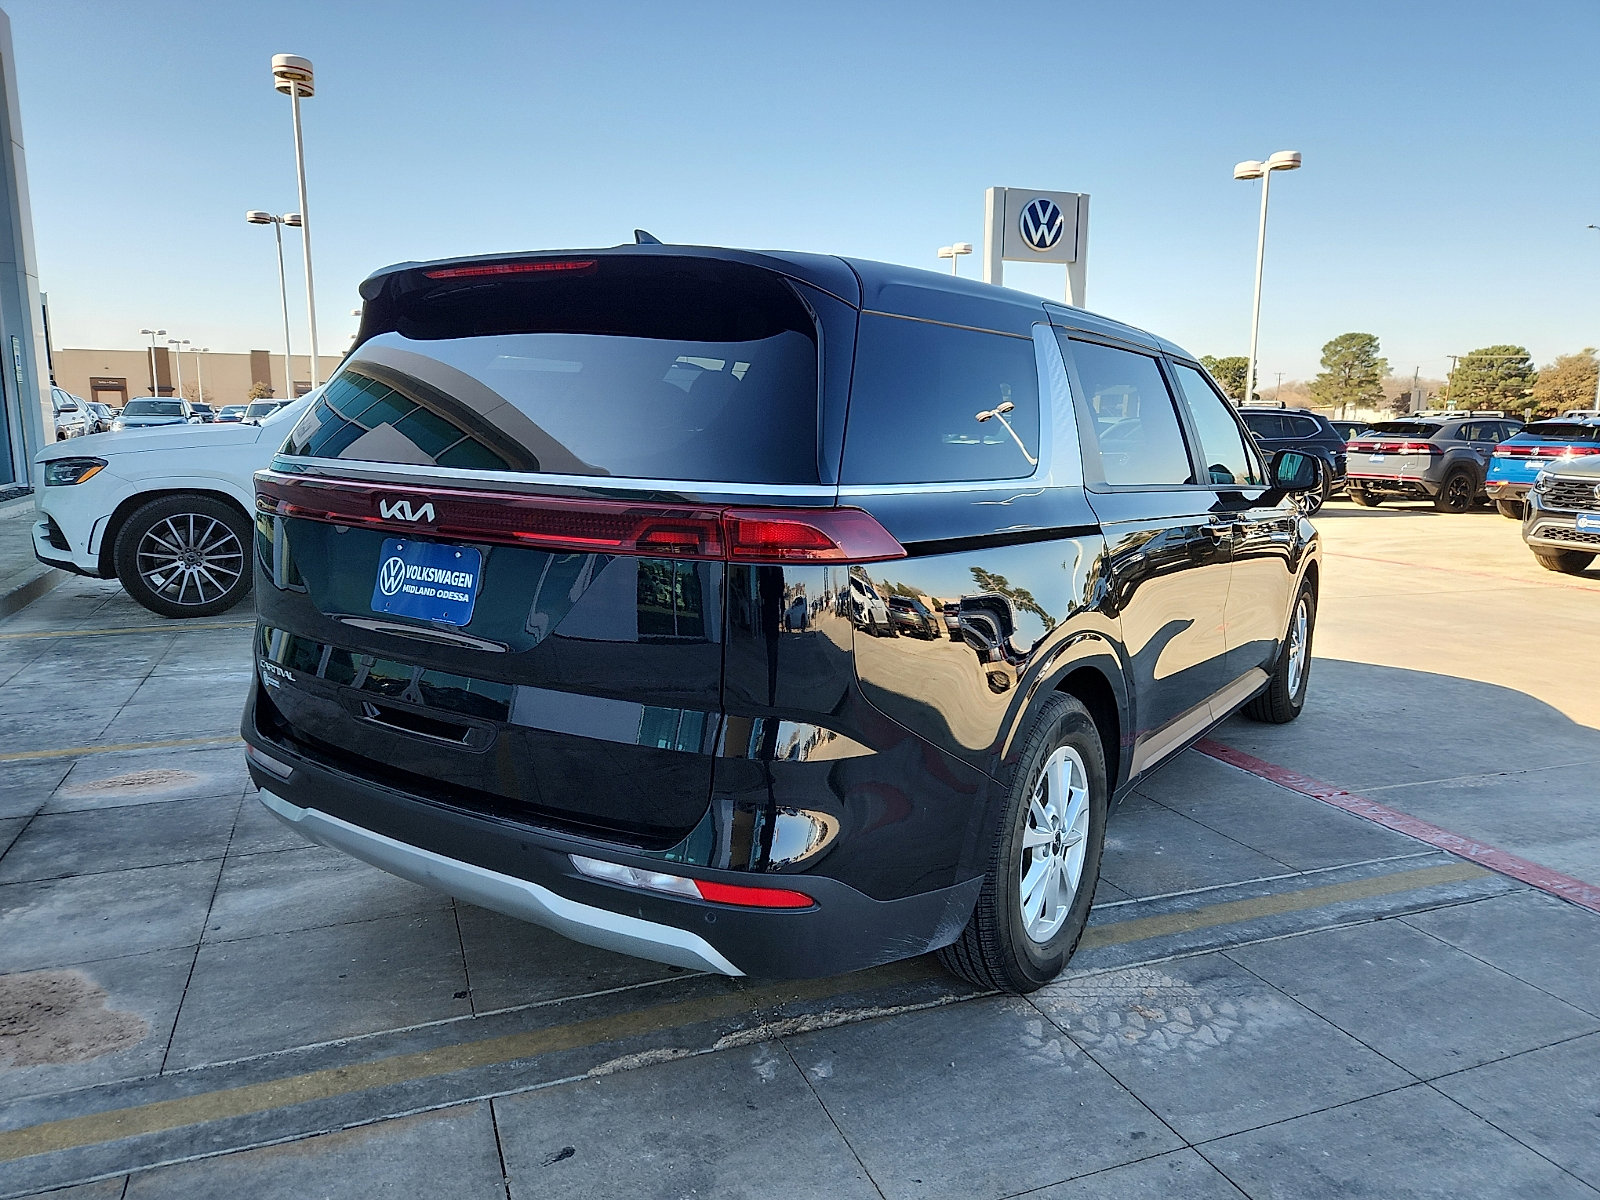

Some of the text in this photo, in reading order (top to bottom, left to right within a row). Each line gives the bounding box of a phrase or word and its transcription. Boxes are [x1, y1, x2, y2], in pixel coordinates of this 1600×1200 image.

[1019, 198, 1064, 252] VW
[380, 499, 435, 522] KIA
[406, 565, 473, 588] VOLKSWAGEN
[402, 584, 469, 602] MIDLAND ODESSA
